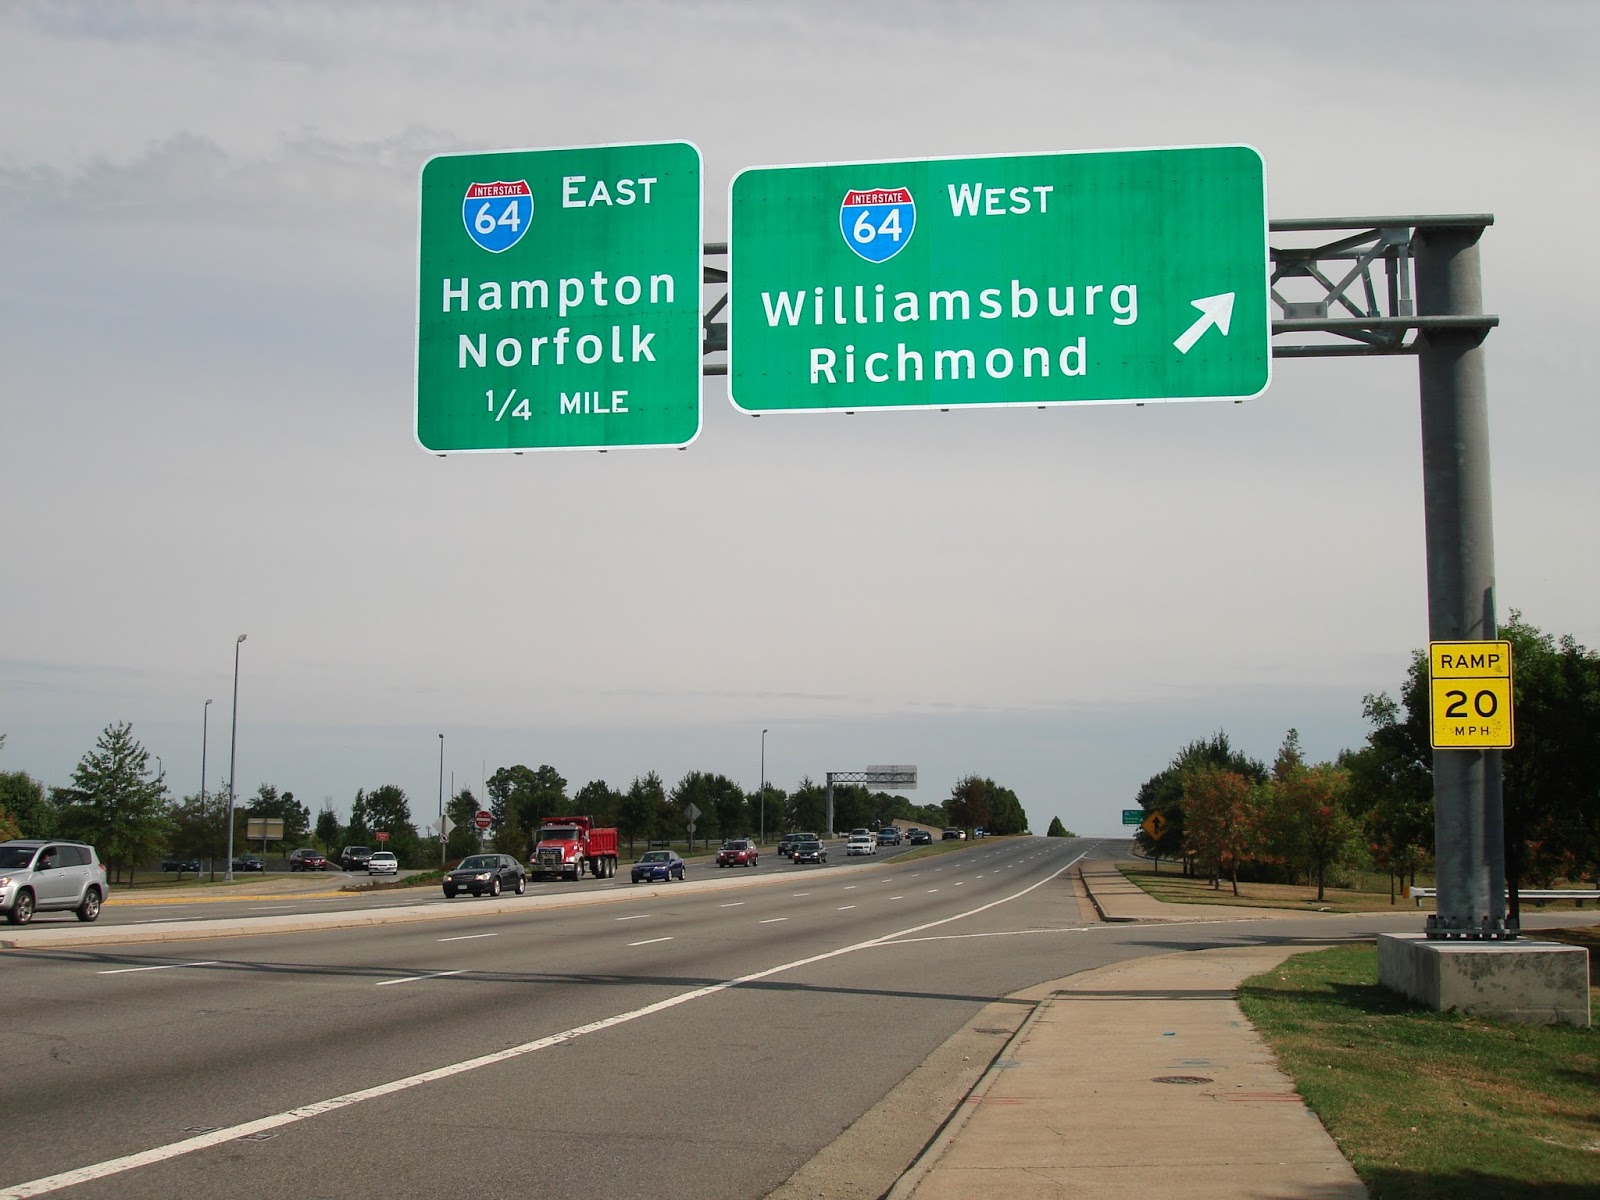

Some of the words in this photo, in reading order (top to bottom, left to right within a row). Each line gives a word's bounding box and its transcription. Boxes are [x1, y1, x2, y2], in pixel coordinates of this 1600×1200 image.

[474, 185, 522, 196] INTERSTATE
[562, 175, 657, 208] EAST
[851, 191, 903, 204] INTERSTATE
[948, 182, 1054, 217] WEST
[474, 201, 520, 234] 64
[852, 209, 902, 244] 64
[442, 271, 675, 317] Hampton
[761, 280, 1139, 326] Williamsburg
[458, 325, 656, 369] Norfolk
[809, 337, 1087, 384] Richmond
[486, 389, 532, 422] 1/4
[560, 390, 629, 415] MILE
[1441, 654, 1500, 668] RAMP
[1445, 690, 1498, 718] 20
[1455, 726, 1490, 736] MPH
